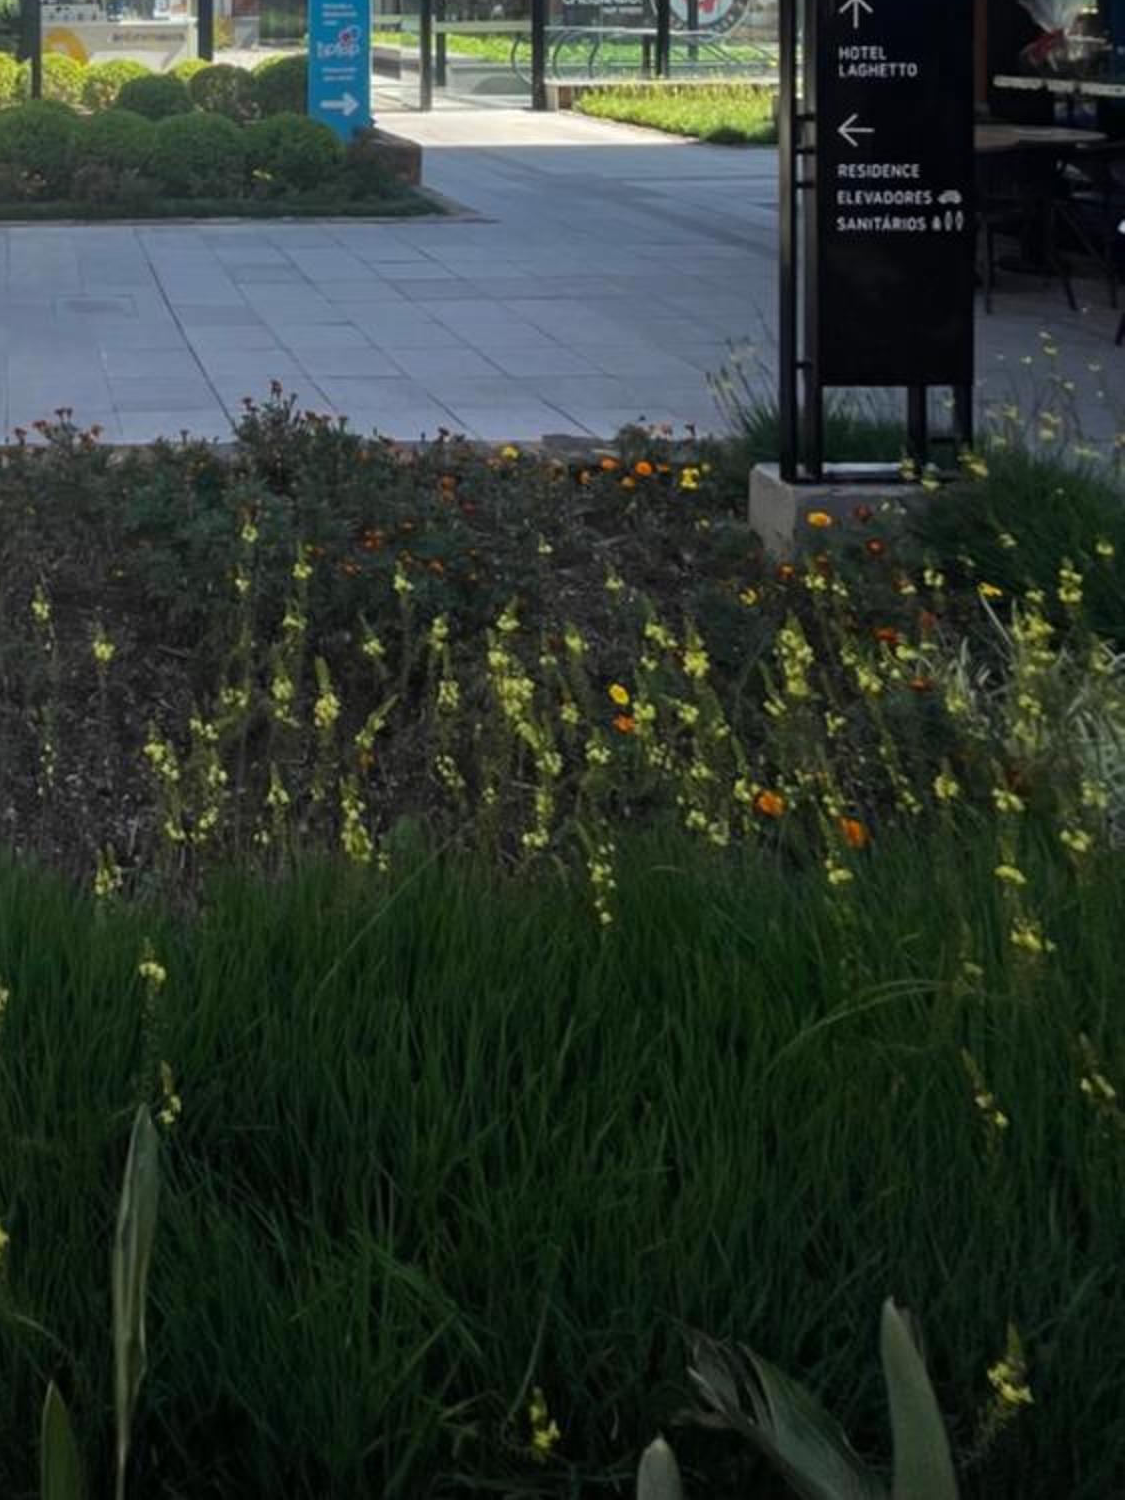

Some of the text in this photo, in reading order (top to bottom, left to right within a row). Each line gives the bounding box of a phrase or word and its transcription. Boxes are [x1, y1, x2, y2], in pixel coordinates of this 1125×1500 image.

[838, 46, 887, 60] HOTEL
[838, 63, 918, 77] LAGHETTO
[837, 164, 920, 178] RESIDENCE
[836, 190, 933, 204] ELEVADORES
[836, 213, 926, 231] SANITÁRIOS
